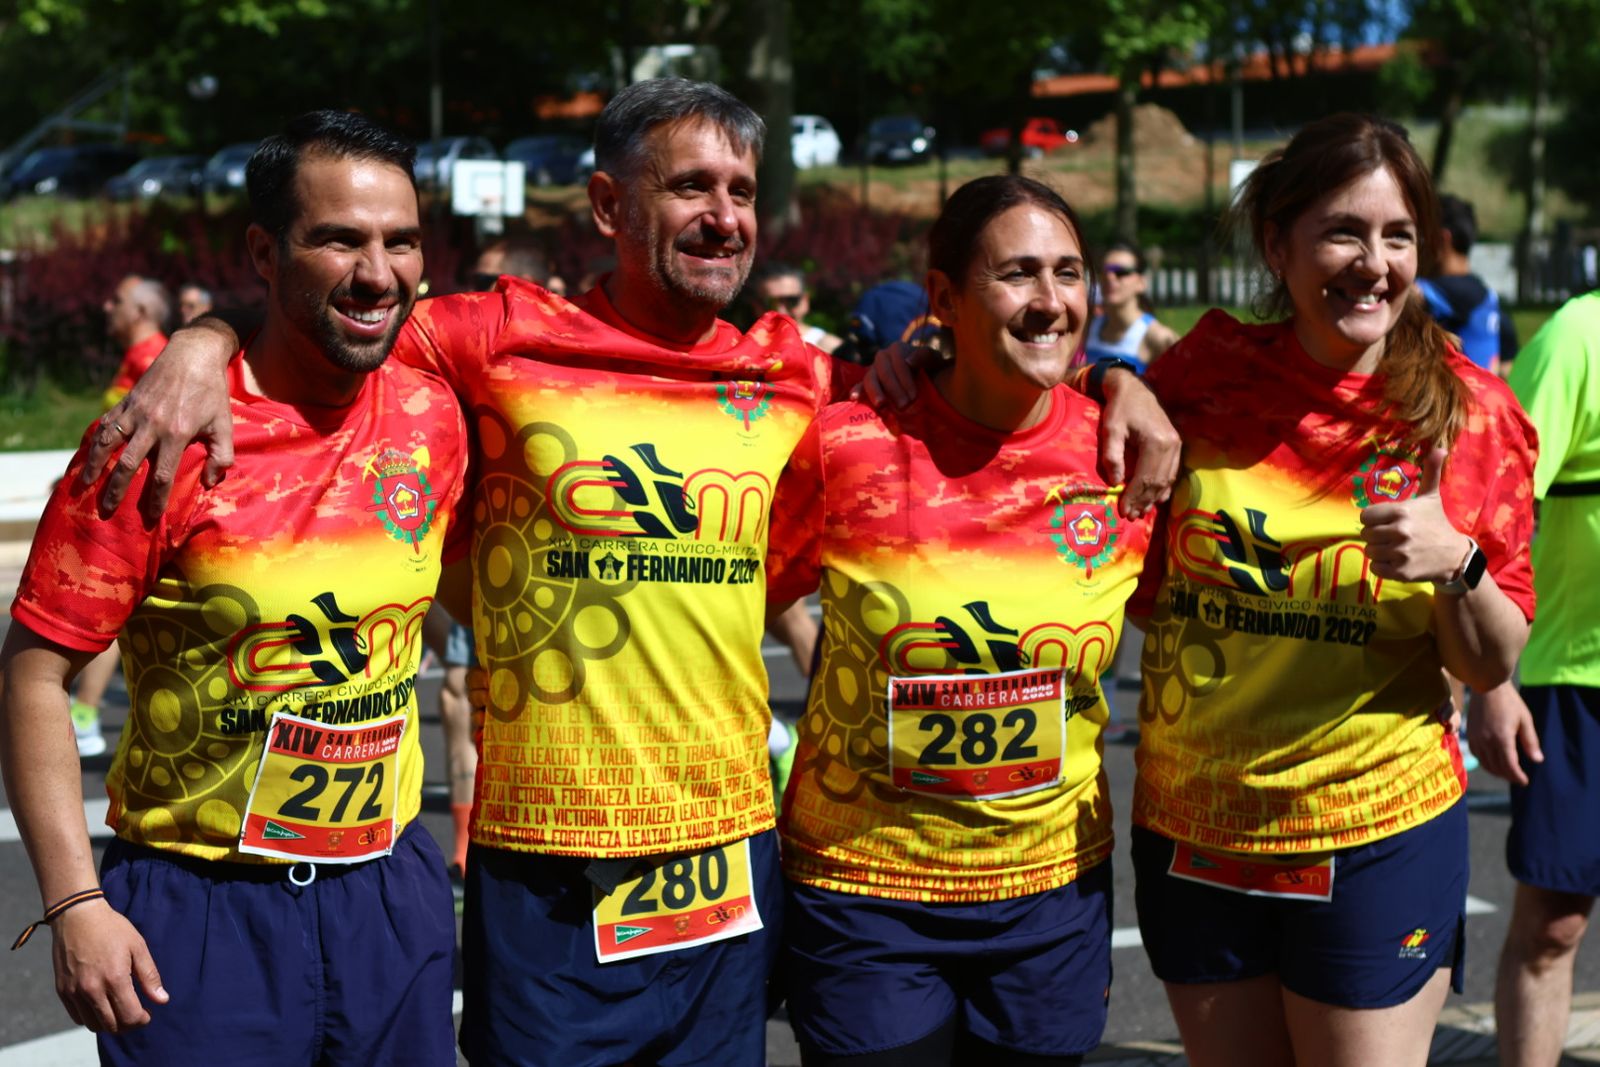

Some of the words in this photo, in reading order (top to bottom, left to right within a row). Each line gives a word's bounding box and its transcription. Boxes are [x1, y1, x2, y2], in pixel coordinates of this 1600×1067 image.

[549, 537, 573, 548] XIV
[580, 539, 659, 552] CARRERA
[546, 551, 589, 578] SAN
[627, 555, 726, 584] FERNANDO
[1225, 604, 1321, 641] FERNANDO
[256, 689, 333, 706] CARRERA
[896, 684, 937, 706] XIV
[943, 683, 970, 695] SAN
[985, 673, 1058, 693] FERNANDO
[941, 690, 1018, 707] CARRERA
[220, 708, 266, 734] SAN
[300, 693, 392, 726] FERNANDO
[274, 723, 322, 755] XIV
[326, 733, 354, 746] SAN
[547, 726, 585, 744] VALOR
[592, 727, 618, 744] POR
[638, 725, 689, 744] TRABAJO
[917, 708, 1038, 765] 282
[322, 742, 380, 760] CARRERA
[531, 747, 580, 766] LEALTAD
[587, 748, 594, 766] Y
[600, 748, 638, 766] VALOR
[666, 746, 680, 764] EL
[514, 766, 578, 786] FORTALEZA
[584, 768, 634, 786] LEALTAD
[640, 767, 647, 785] Y
[685, 763, 708, 782] POR
[712, 761, 721, 779] EL
[277, 762, 385, 822] 272
[561, 788, 631, 806] FORTALEZA
[636, 784, 678, 806] LEALTAD
[691, 780, 722, 800] VALOR
[1296, 798, 1311, 814] EL
[1317, 786, 1369, 813] TRABAJO
[524, 807, 531, 824] A
[536, 807, 548, 825] LA
[554, 808, 609, 827] VICTORIA
[615, 805, 676, 827] FORTALEZA
[680, 799, 718, 821] LEALTAD
[722, 799, 729, 816] Y
[1260, 834, 1311, 852] LEALTAD
[1318, 833, 1326, 849] Y
[1331, 825, 1369, 847] VALOR
[1375, 814, 1400, 837] POR
[1402, 808, 1418, 825] EL
[1420, 780, 1461, 817] TRABAJO
[1278, 814, 1314, 833] VALOR
[1320, 811, 1346, 832] POR
[1350, 807, 1366, 825] EL
[1370, 786, 1419, 818] TRABAJO
[552, 829, 622, 849] FORTALEZA
[627, 826, 673, 848] LEALTAD
[676, 825, 683, 842] Y
[686, 820, 715, 841] VALOR
[718, 817, 736, 837] POR
[621, 848, 728, 916] 280
